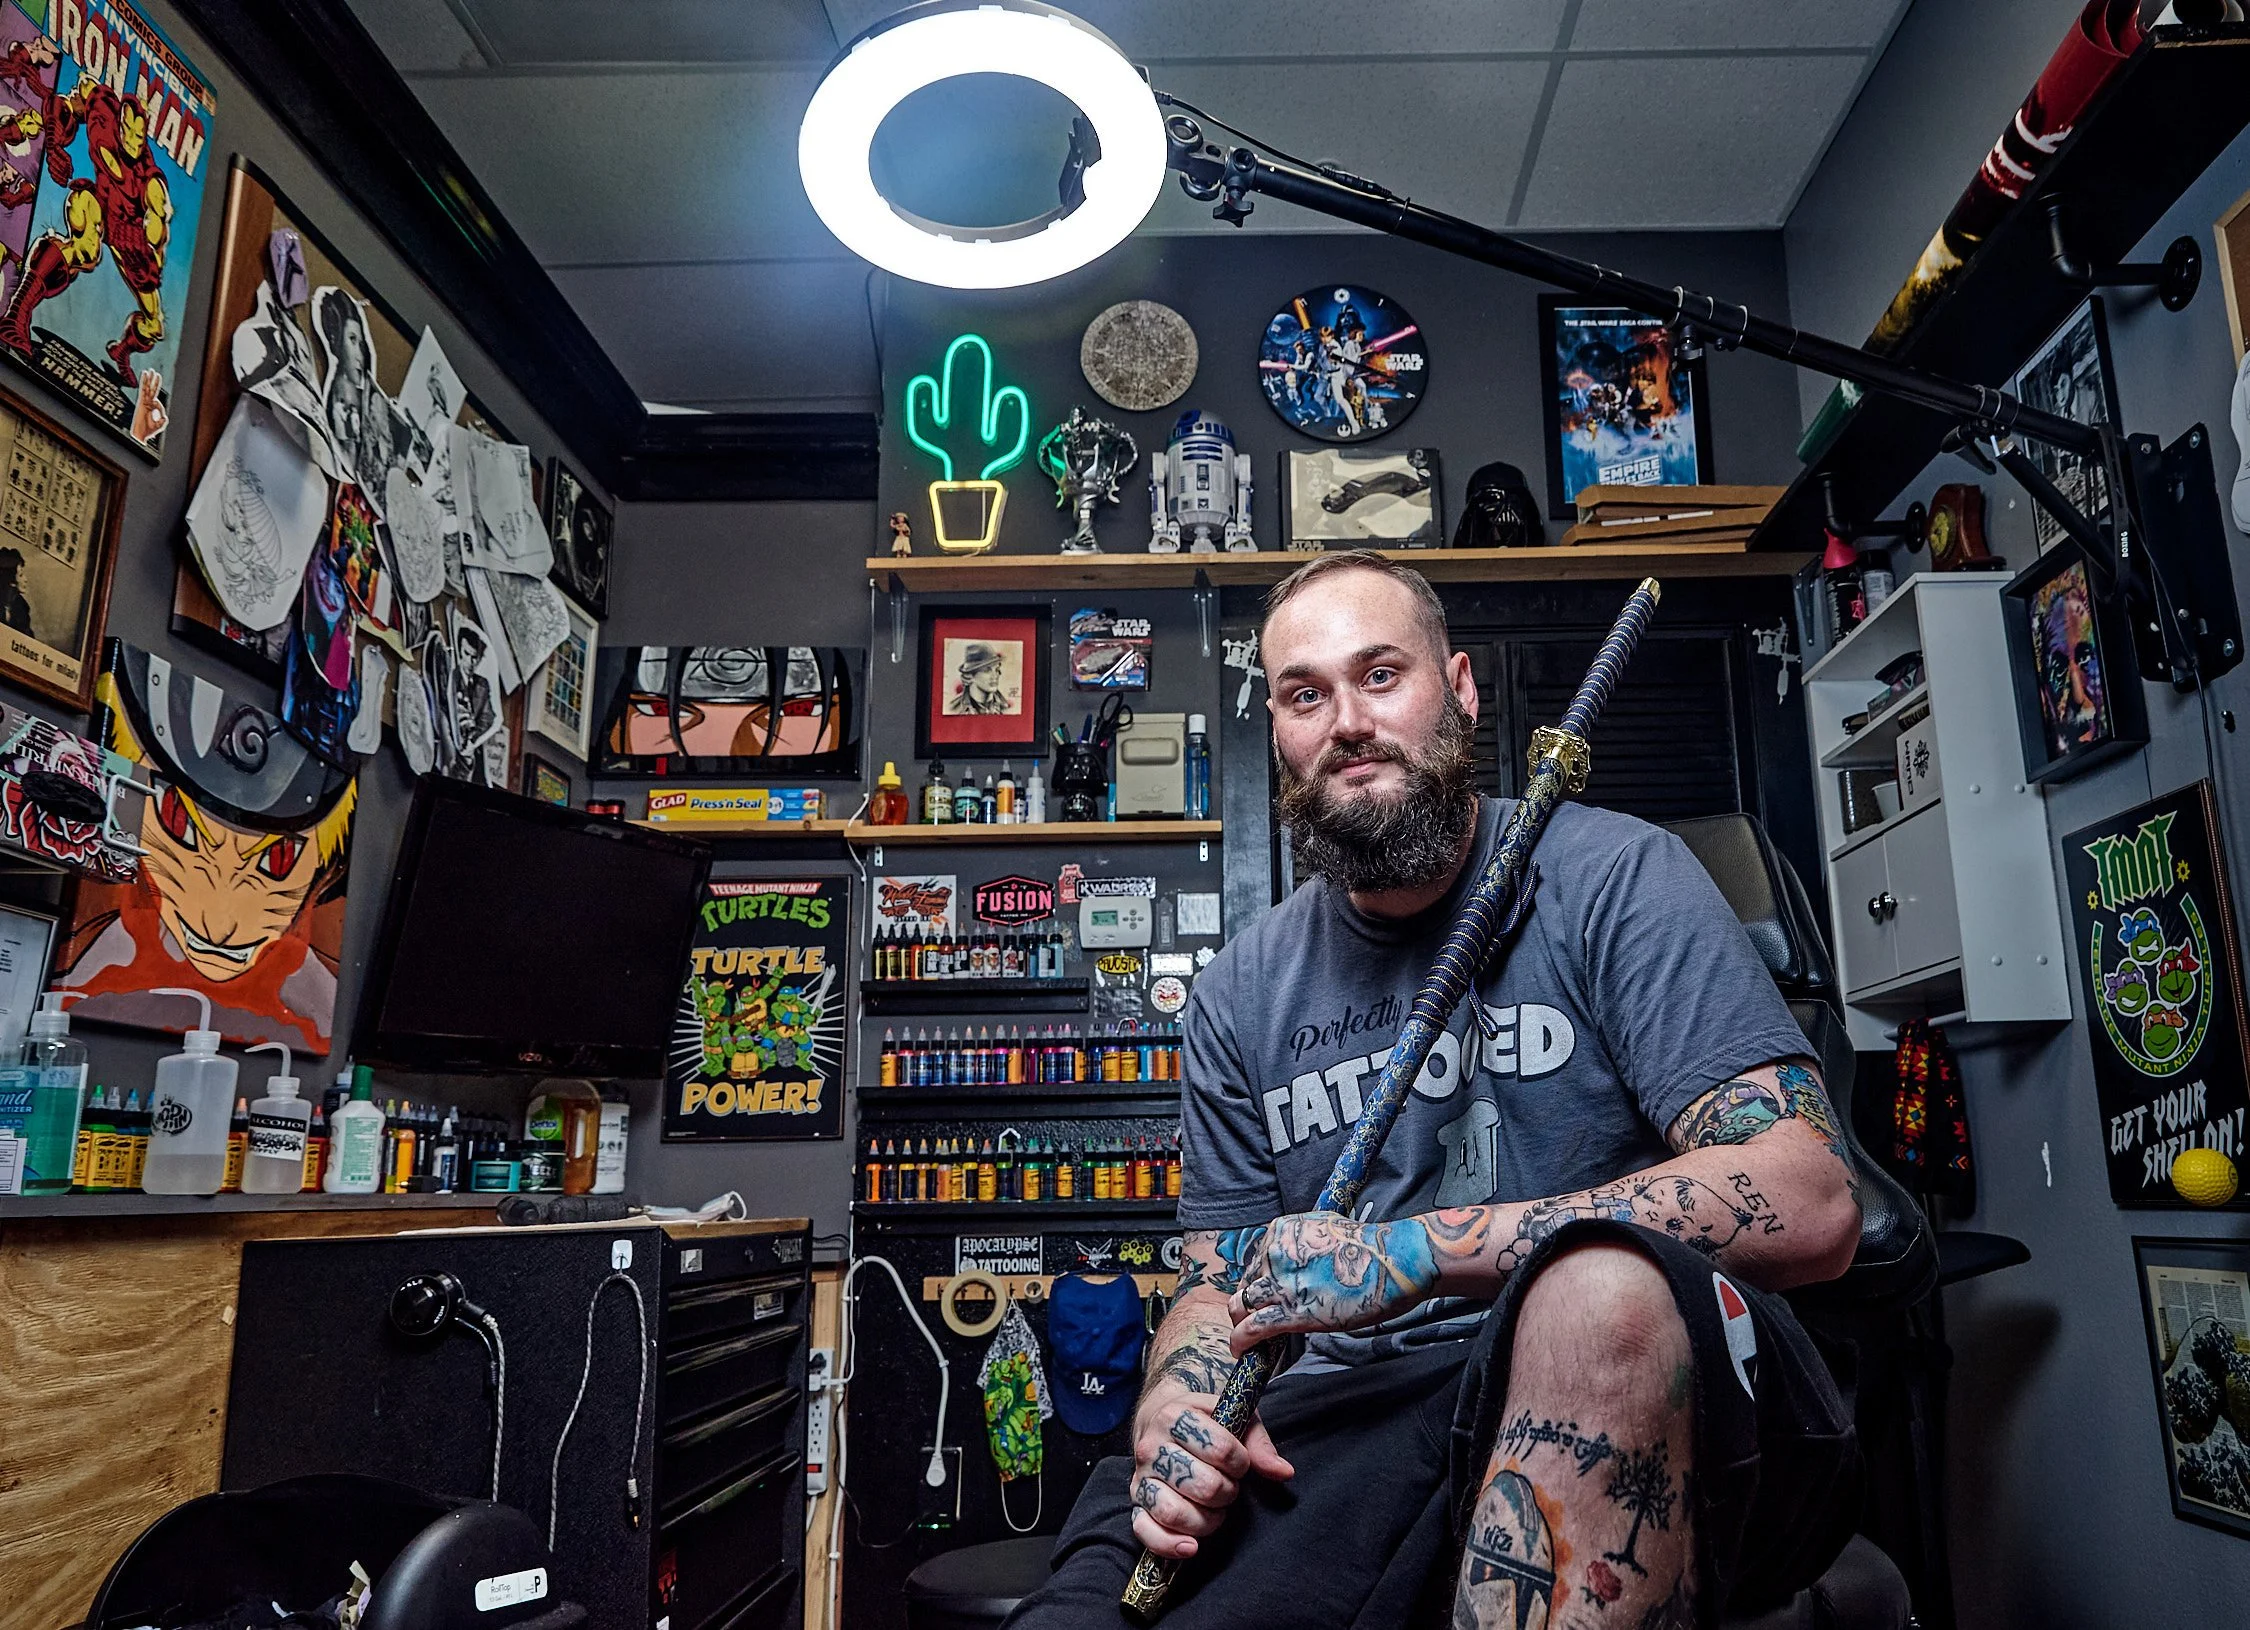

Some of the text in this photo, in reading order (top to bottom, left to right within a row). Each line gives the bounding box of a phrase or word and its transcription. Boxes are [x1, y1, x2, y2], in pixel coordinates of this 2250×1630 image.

[103, 1, 200, 114] INVINCIBLE
[116, 0, 205, 102] COMICS GROUP
[48, 0, 205, 177] IRON MAN
[1385, 361, 1423, 371] WARS
[1388, 353, 1422, 364] STAR
[41, 356, 124, 420] HAMMER!
[1599, 458, 1660, 482] EMPIRE
[1112, 626, 1151, 637] WARS
[1114, 618, 1151, 629] STAR
[11, 640, 39, 662] tattoos
[42, 654, 53, 668] for
[1903, 740, 1915, 796] WAND
[651, 795, 686, 810] GLAD
[690, 798, 732, 809] Press'n
[735, 798, 762, 809] Seal
[2083, 810, 2177, 912] TMNT
[712, 883, 818, 895] TEENAGE MUTANT NINJA
[976, 890, 1052, 912] FUSION
[701, 893, 831, 933] TURTLES
[690, 946, 827, 977] TURTLE
[2190, 910, 2212, 1018] TURTLES
[2092, 936, 2117, 1035] TEENAGE
[1290, 999, 1403, 1062] Perfectly
[2173, 1026, 2204, 1067] NINJA
[2117, 1038, 2169, 1074] MUTANT
[680, 1076, 826, 1116] POWER!
[1262, 1002, 1577, 1154] TATOOED
[530, 1120, 557, 1128] Dettol
[2111, 1079, 2207, 1155] GET YOUR
[2203, 1107, 2245, 1158] ON!
[1727, 1171, 1785, 1236] REN
[962, 1237, 1039, 1255] APOCALYPSE
[977, 1257, 1040, 1273] TATTOOING
[1081, 1372, 1105, 1395] LA
